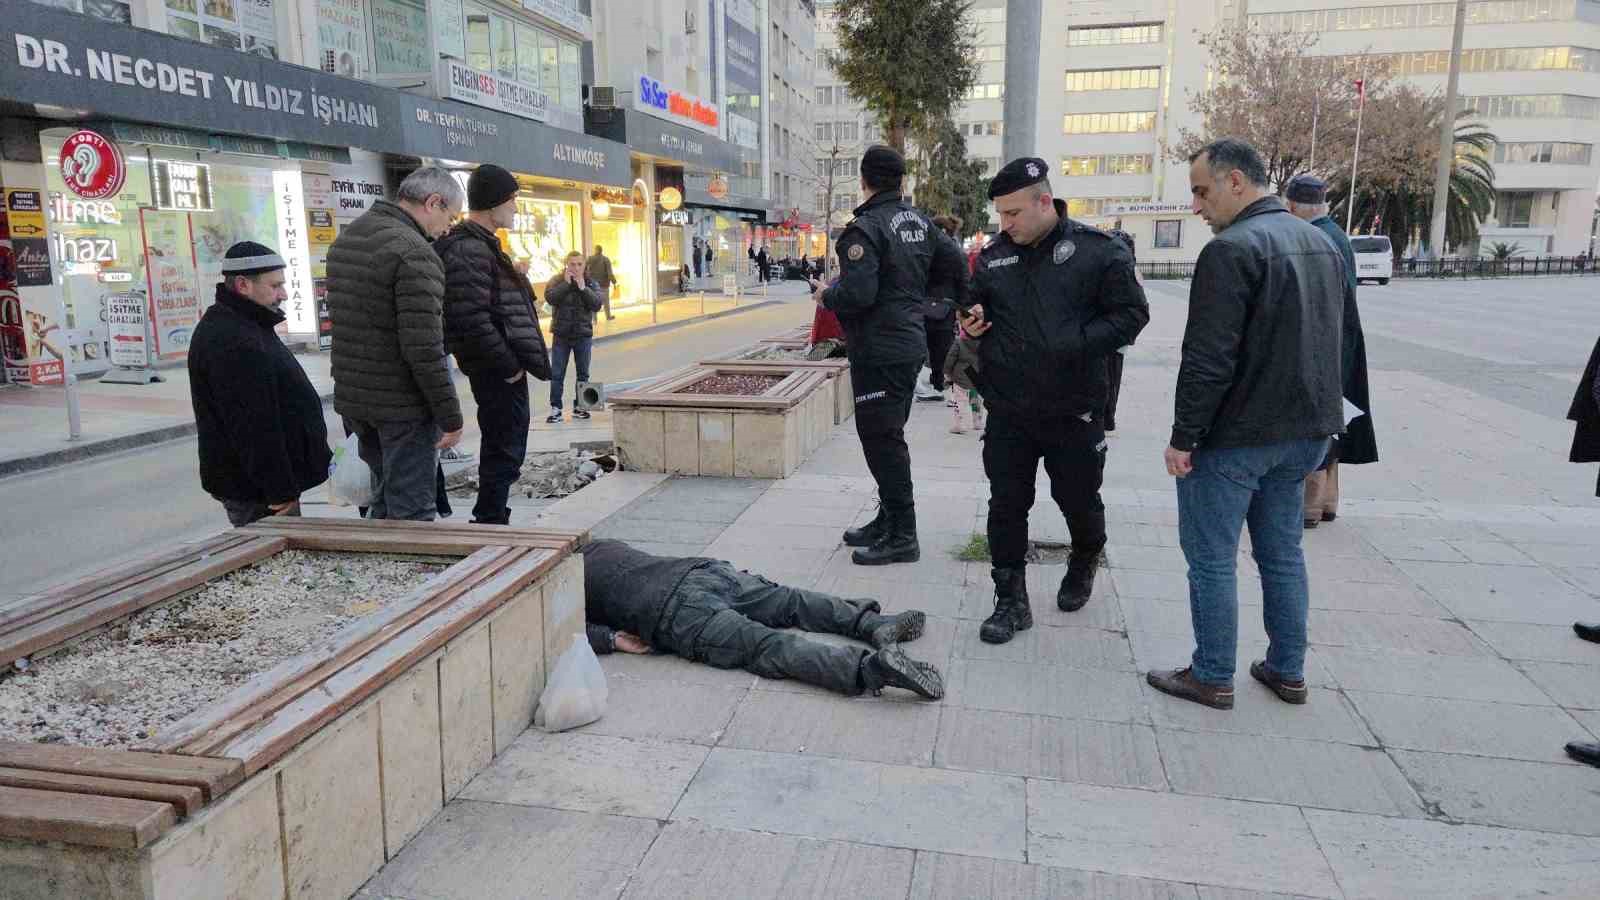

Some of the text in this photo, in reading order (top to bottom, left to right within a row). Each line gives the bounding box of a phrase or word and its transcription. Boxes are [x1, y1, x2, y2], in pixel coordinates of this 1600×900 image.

[15, 33, 379, 128] DR. NECDET YILDIZ İŞHANI
[332, 178, 355, 194] TEVFİK
